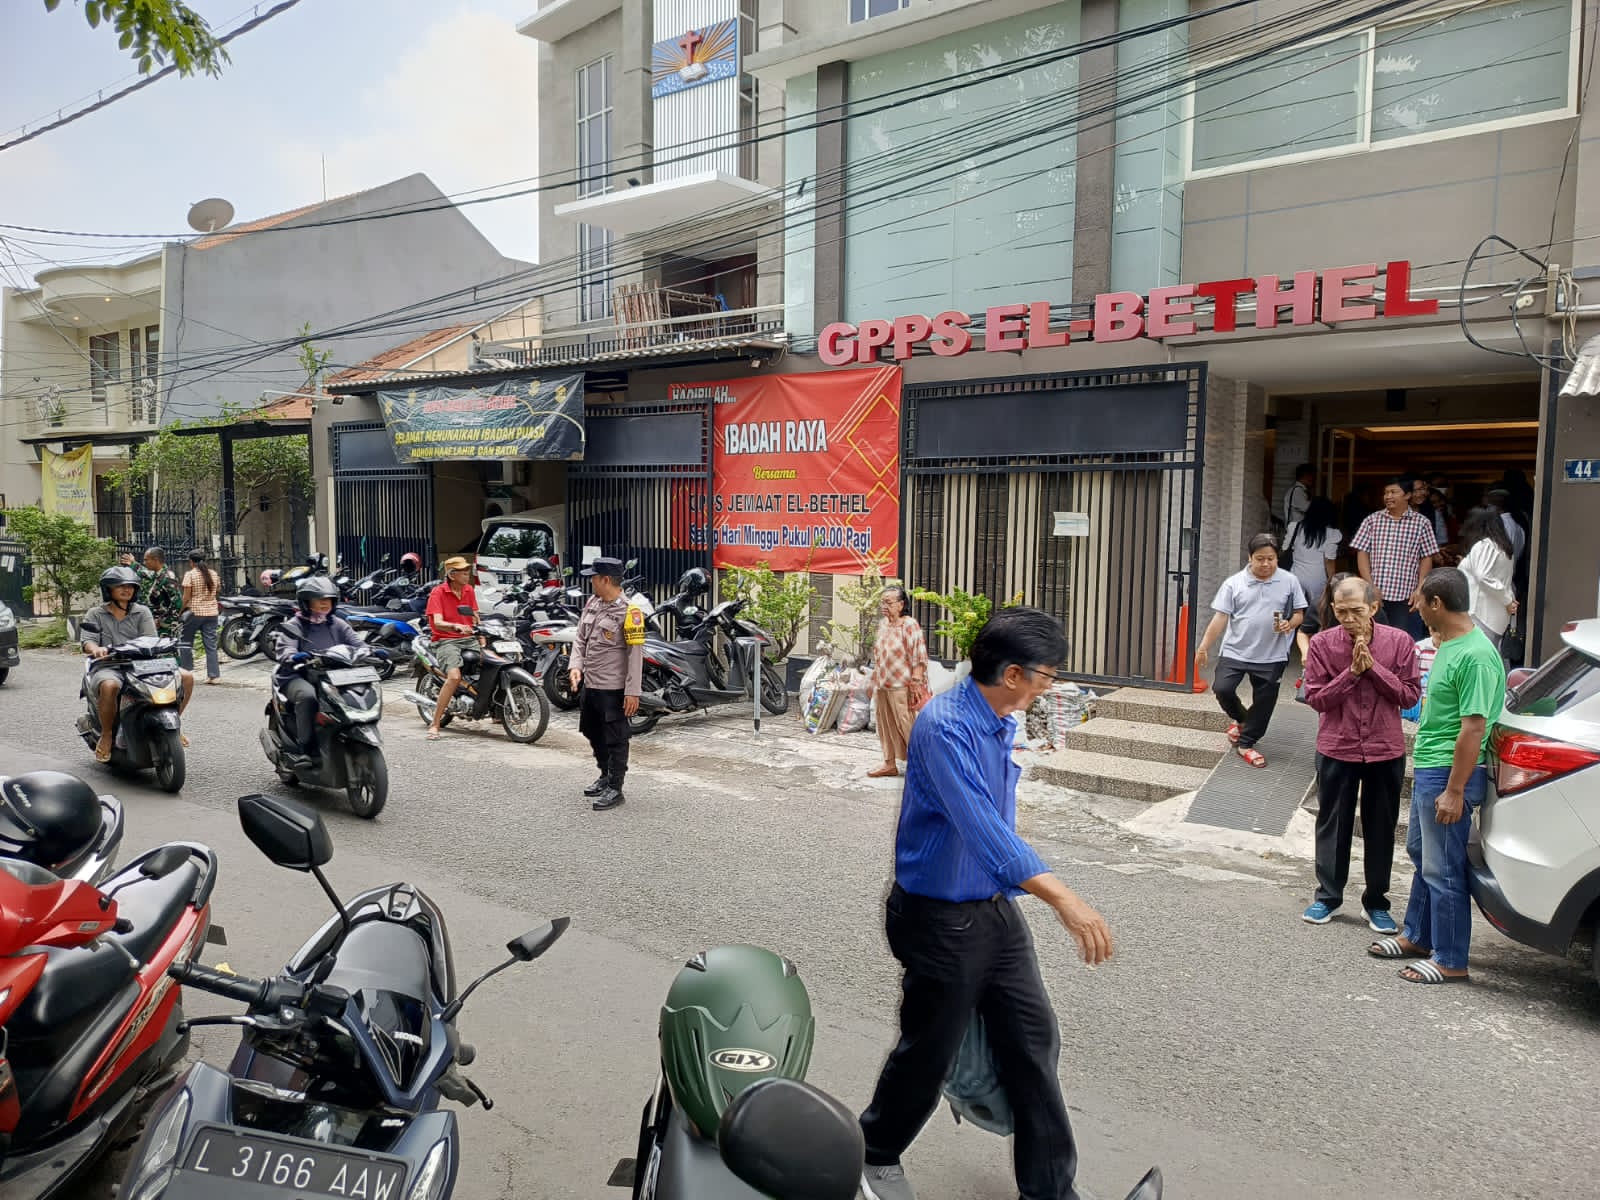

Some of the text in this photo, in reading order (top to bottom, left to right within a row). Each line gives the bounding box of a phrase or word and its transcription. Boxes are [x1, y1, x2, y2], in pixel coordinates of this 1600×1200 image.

[818, 261, 1439, 366] GPPS EL-BETHEL
[481, 426, 515, 441] IBADAH
[516, 424, 545, 440] PUASA
[725, 419, 828, 455] IBADAH RAYA
[753, 465, 797, 479] Bersama
[1575, 461, 1592, 477] 44
[690, 493, 870, 513] PS JEMAAT EL-BETHEL
[690, 523, 719, 548] Sep
[722, 525, 741, 545] Hari
[744, 525, 779, 550] Minggu
[782, 525, 811, 546] Pukul
[846, 526, 871, 553] Pagi
[719, 1053, 766, 1066] GIX
[194, 1139, 397, 1200] L 3166 AAW
